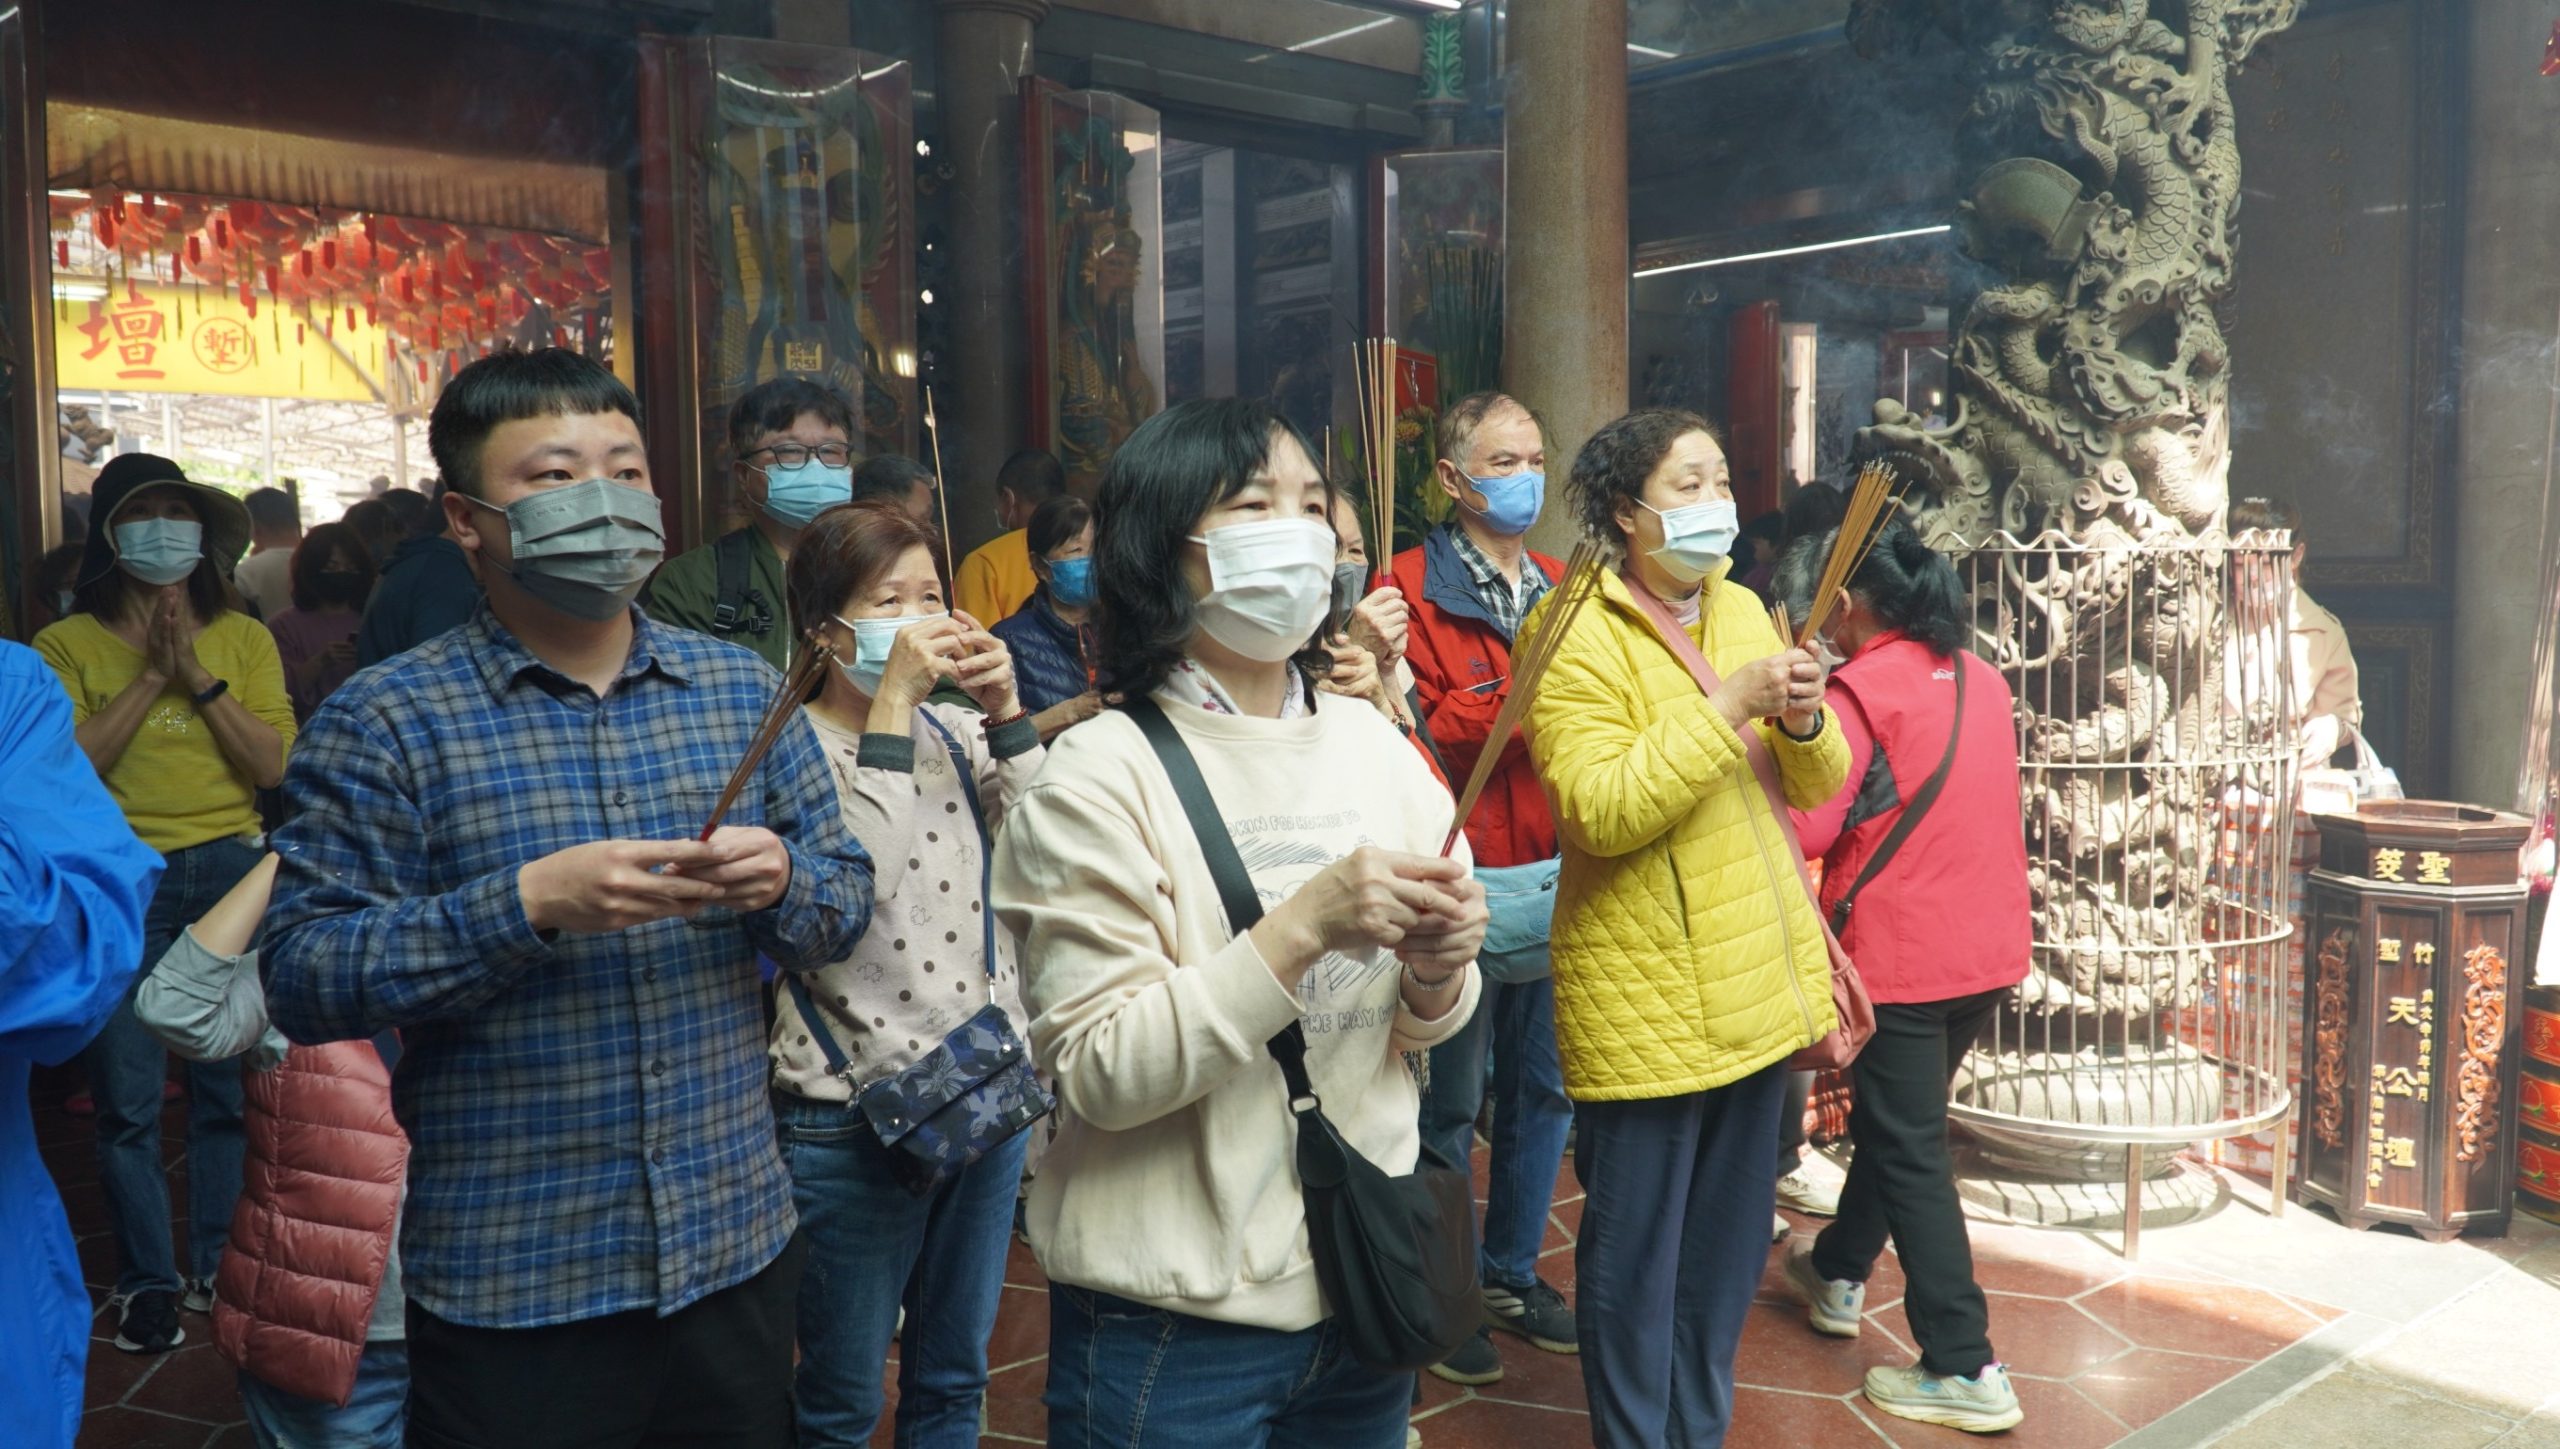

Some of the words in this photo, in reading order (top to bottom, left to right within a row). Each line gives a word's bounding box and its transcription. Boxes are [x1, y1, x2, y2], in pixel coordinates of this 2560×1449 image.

[78, 277, 166, 379] 壇
[1299, 1013, 1332, 1033] THE
[2385, 996, 2420, 1168] 天公壇
